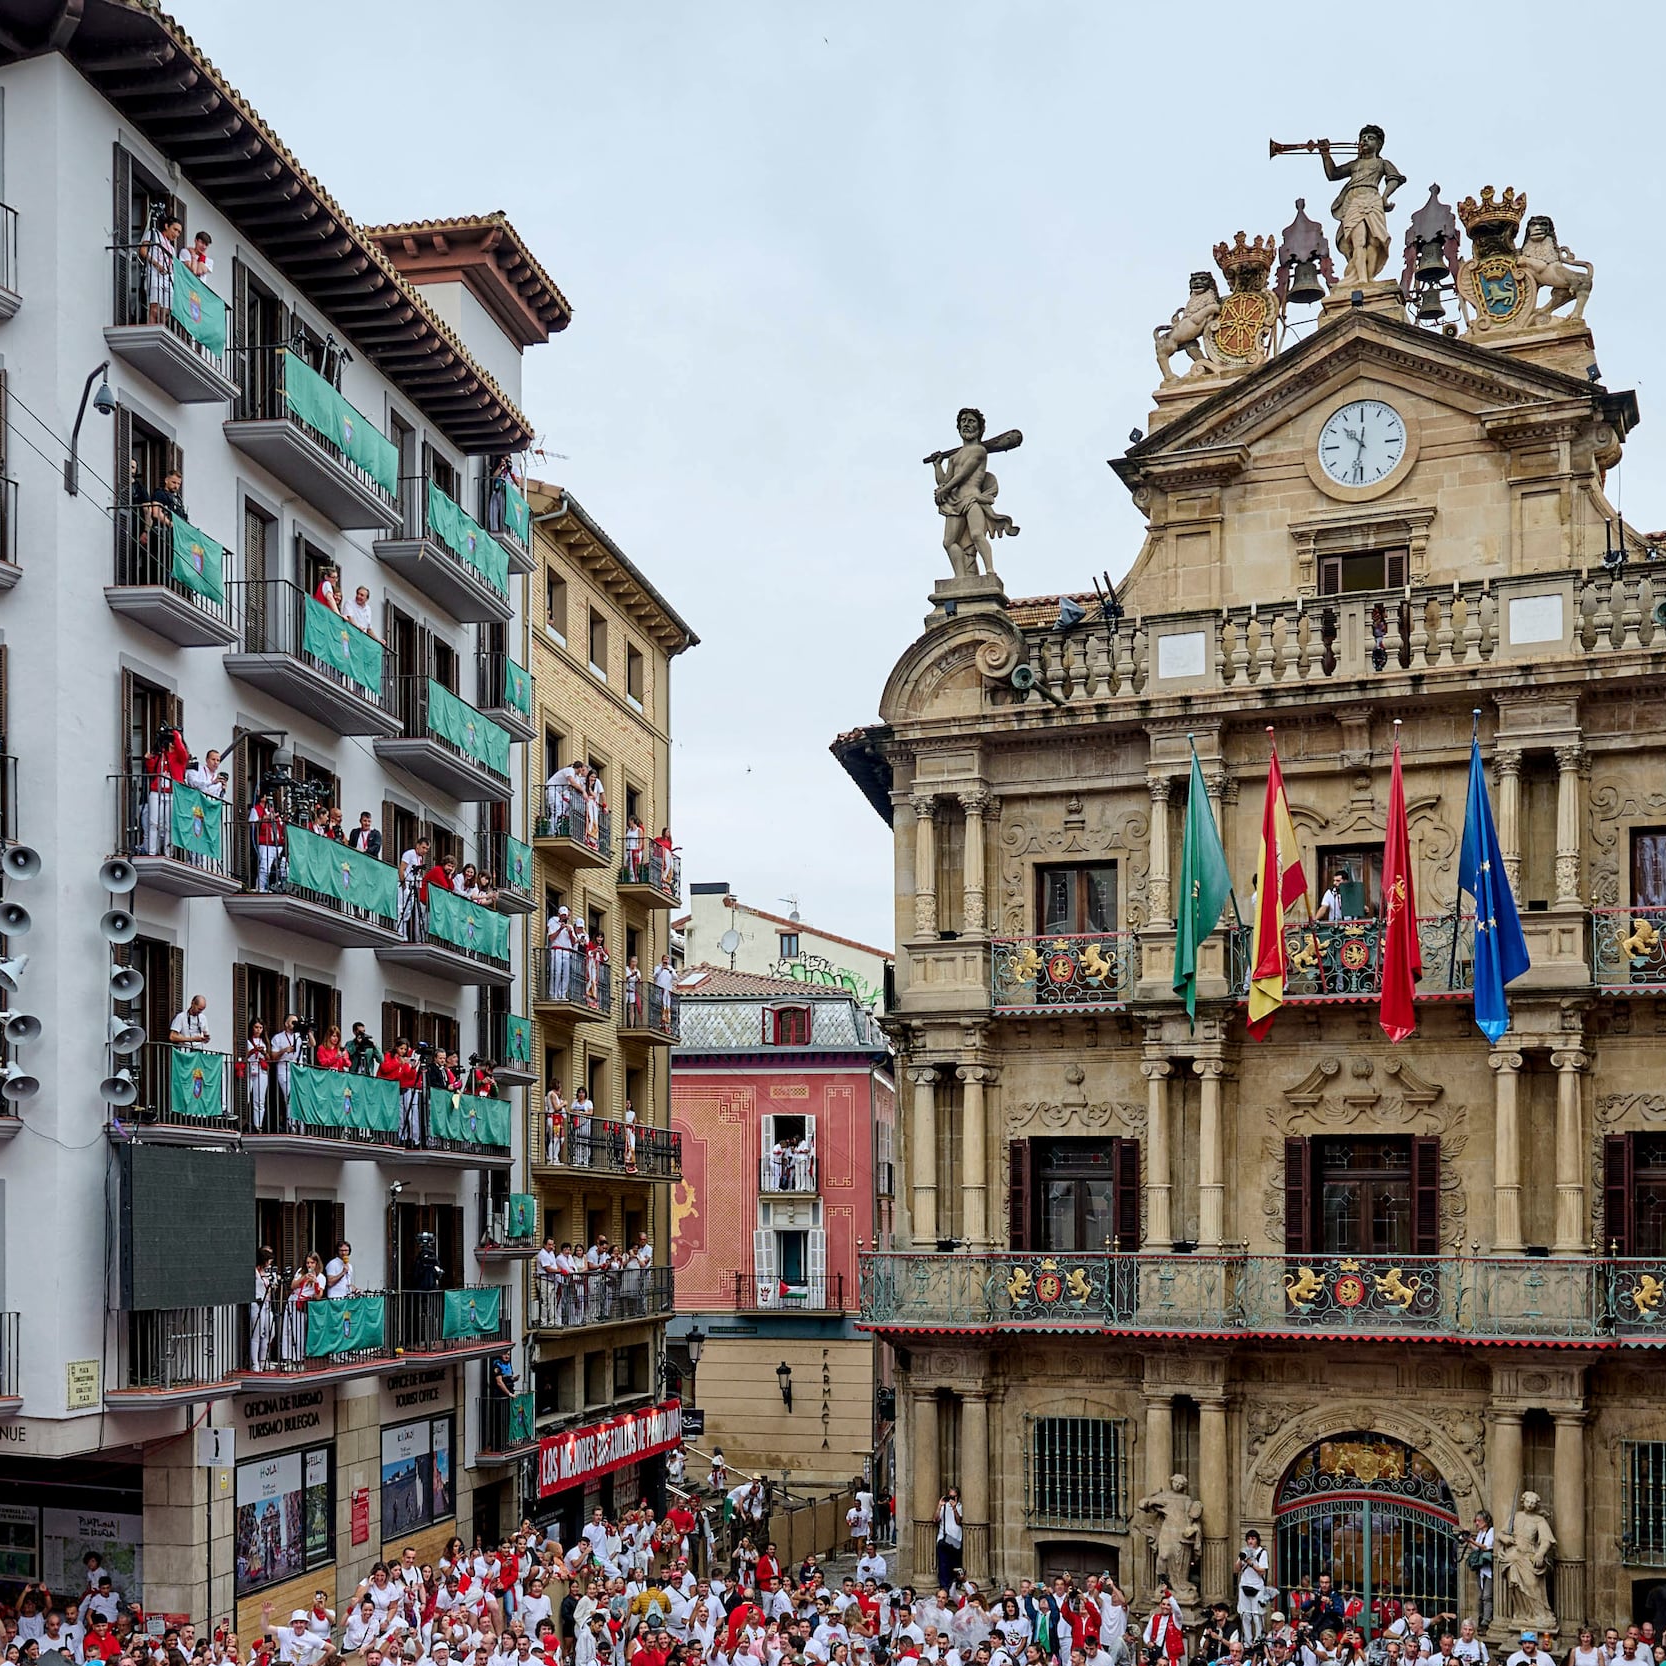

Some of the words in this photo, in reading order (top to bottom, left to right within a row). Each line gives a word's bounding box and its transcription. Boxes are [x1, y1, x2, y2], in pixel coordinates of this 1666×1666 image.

[387, 1374, 408, 1391] OFFICE
[409, 1373, 418, 1386] DE
[244, 1401, 278, 1419] OFICINA
[279, 1398, 291, 1412] DE
[291, 1391, 324, 1409] TURISMO
[395, 1391, 418, 1408] TOURIST
[419, 1387, 440, 1404] OFFICE
[821, 1349, 831, 1450] FARMACIA
[247, 1417, 283, 1440] TURISMO
[284, 1412, 320, 1433] BULEGOA
[542, 1447, 559, 1486] LOS
[559, 1435, 595, 1480] MEJORES
[595, 1420, 637, 1468] BOCADILLOS
[637, 1416, 646, 1452] DE
